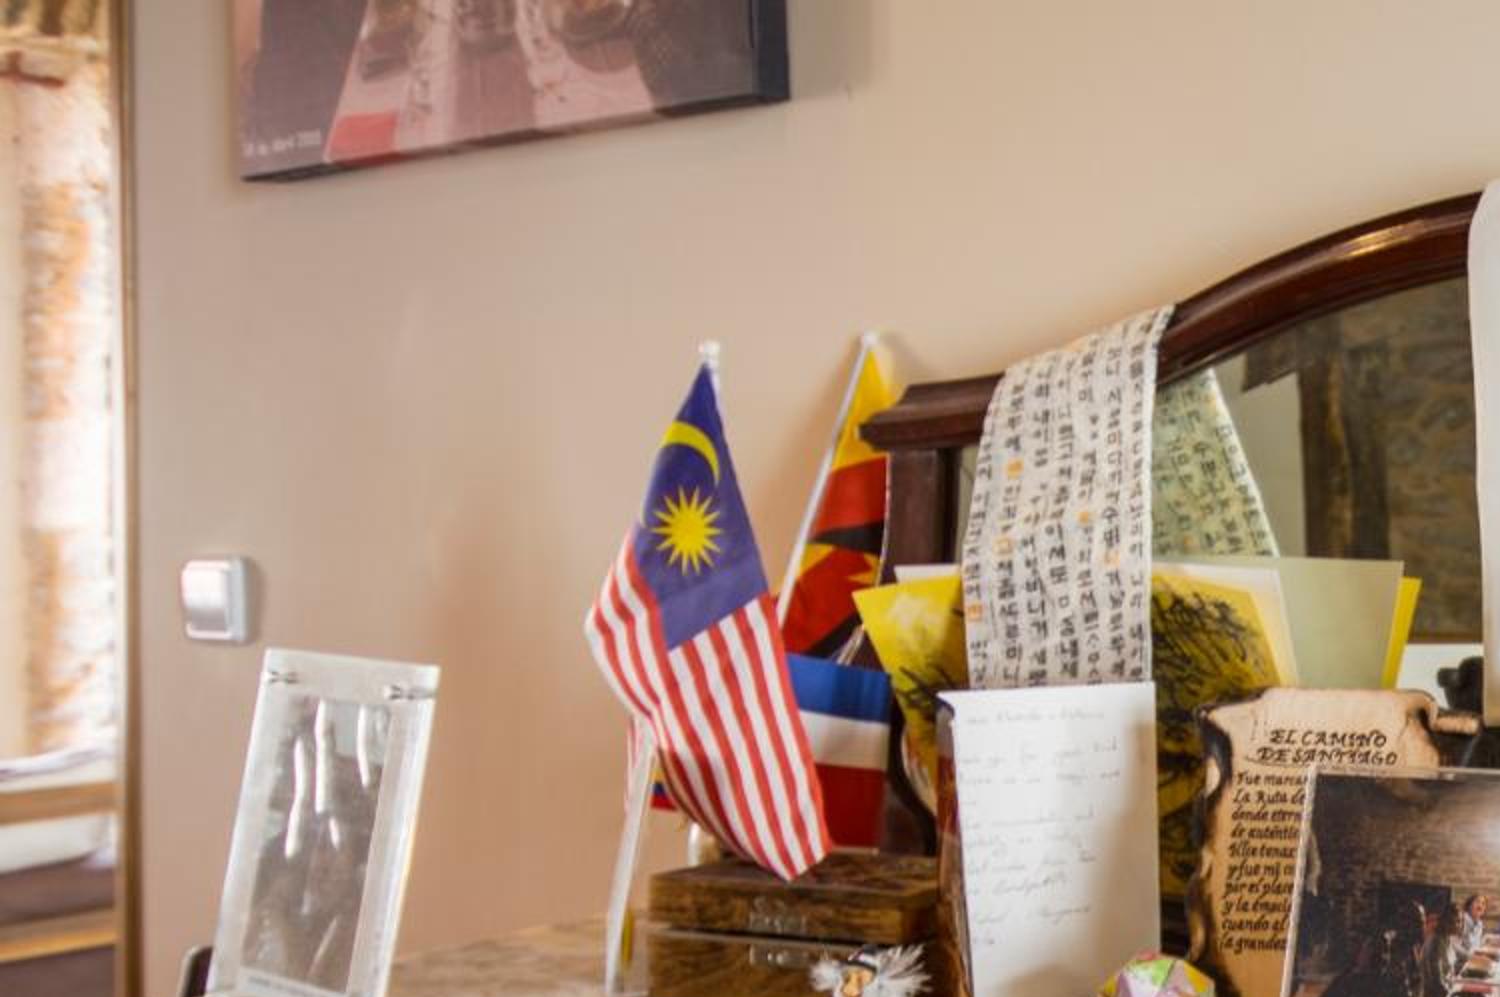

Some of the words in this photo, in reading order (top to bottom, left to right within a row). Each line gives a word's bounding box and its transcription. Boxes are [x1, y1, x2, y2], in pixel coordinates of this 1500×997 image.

[1269, 728, 1296, 745] EL
[1256, 746, 1290, 764] DE
[1291, 747, 1398, 766] SANTIAGO
